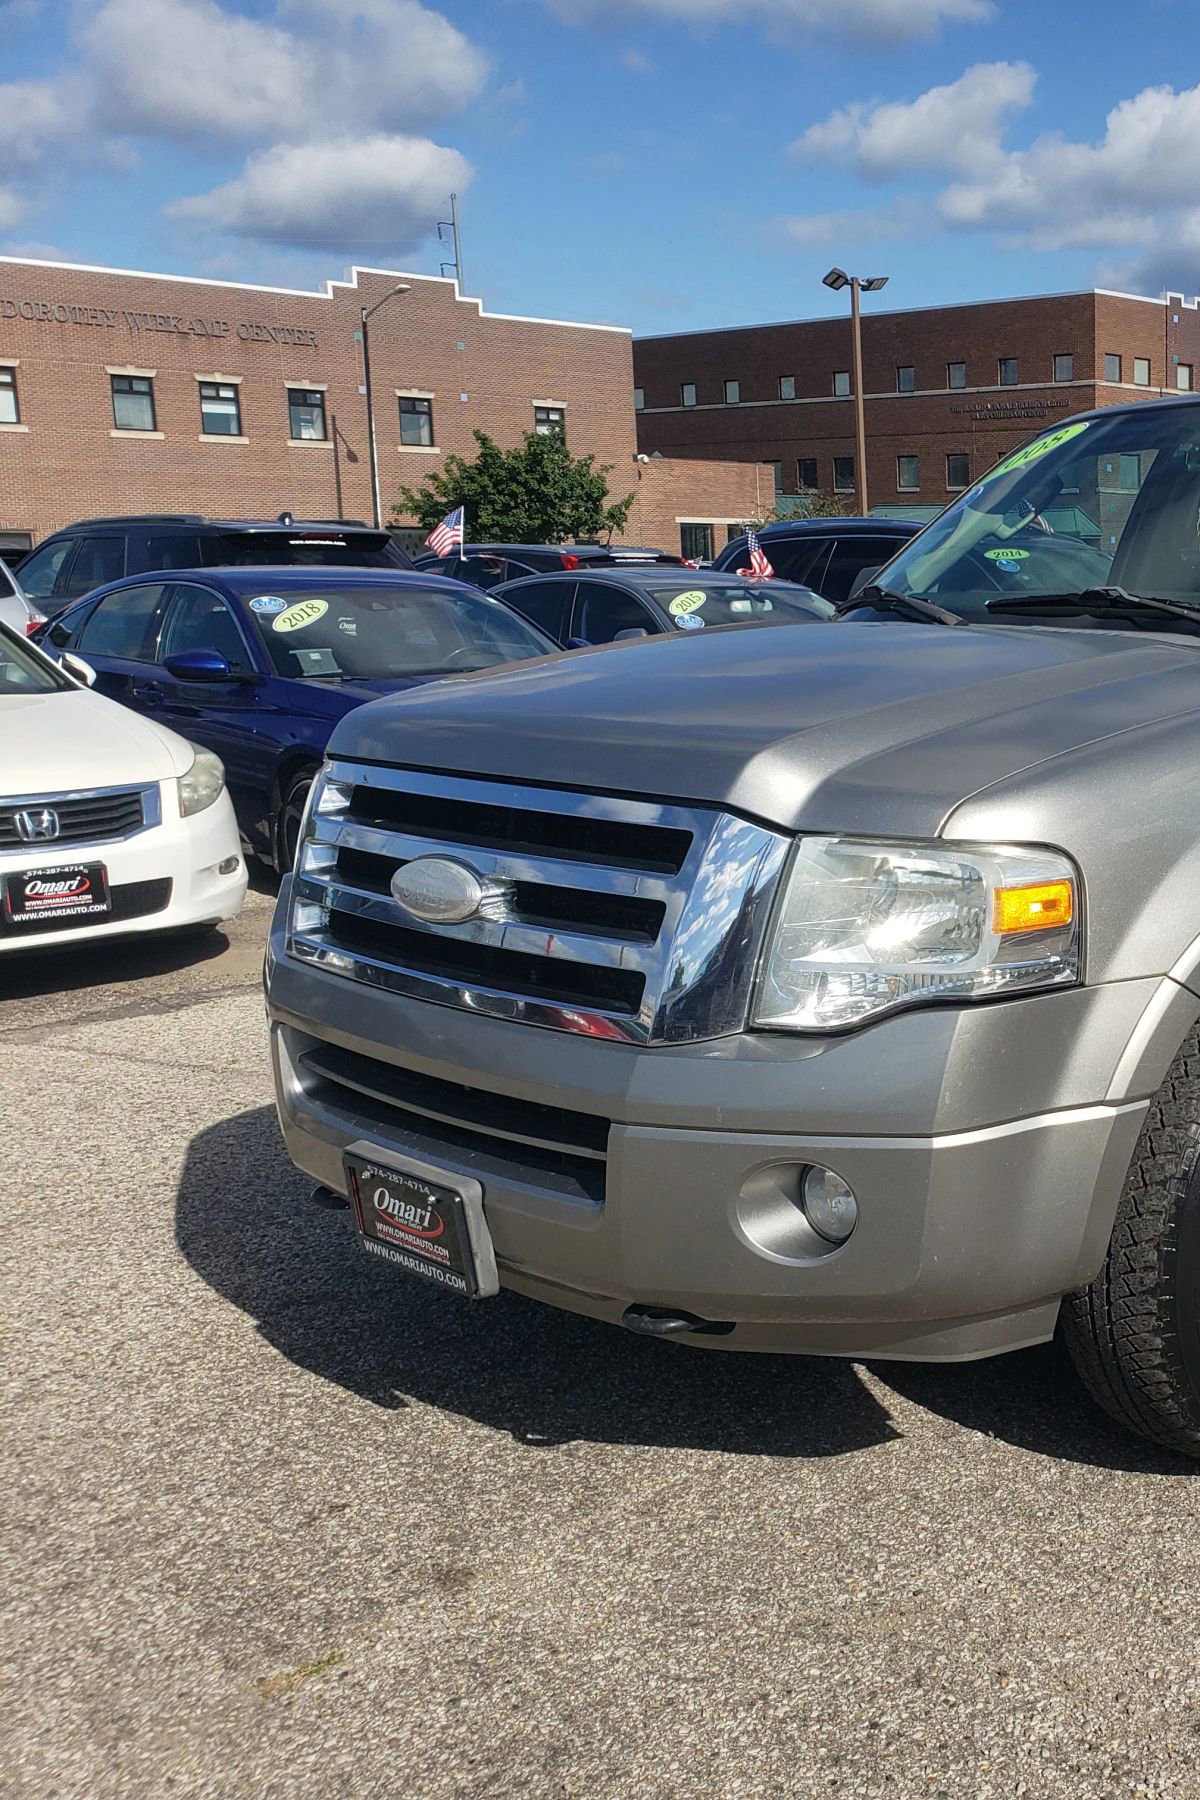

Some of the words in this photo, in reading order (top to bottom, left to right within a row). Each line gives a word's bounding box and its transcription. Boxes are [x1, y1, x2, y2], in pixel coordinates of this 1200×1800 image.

[2, 300, 117, 328] DOROTHY
[236, 323, 319, 347] CENTER
[993, 550, 1022, 558] 2014
[282, 602, 321, 628] 2018
[675, 593, 702, 612] 2015
[25, 875, 82, 895] Omari
[13, 904, 107, 922] WWW.OMARIAUTO.COM
[366, 1165, 431, 1195] 574-287-4714
[373, 1187, 432, 1228] Omari
[375, 1221, 450, 1259] WWW.OMARIAUTO.COM
[363, 1239, 467, 1292] WWW.OMARIAUTO.COM
